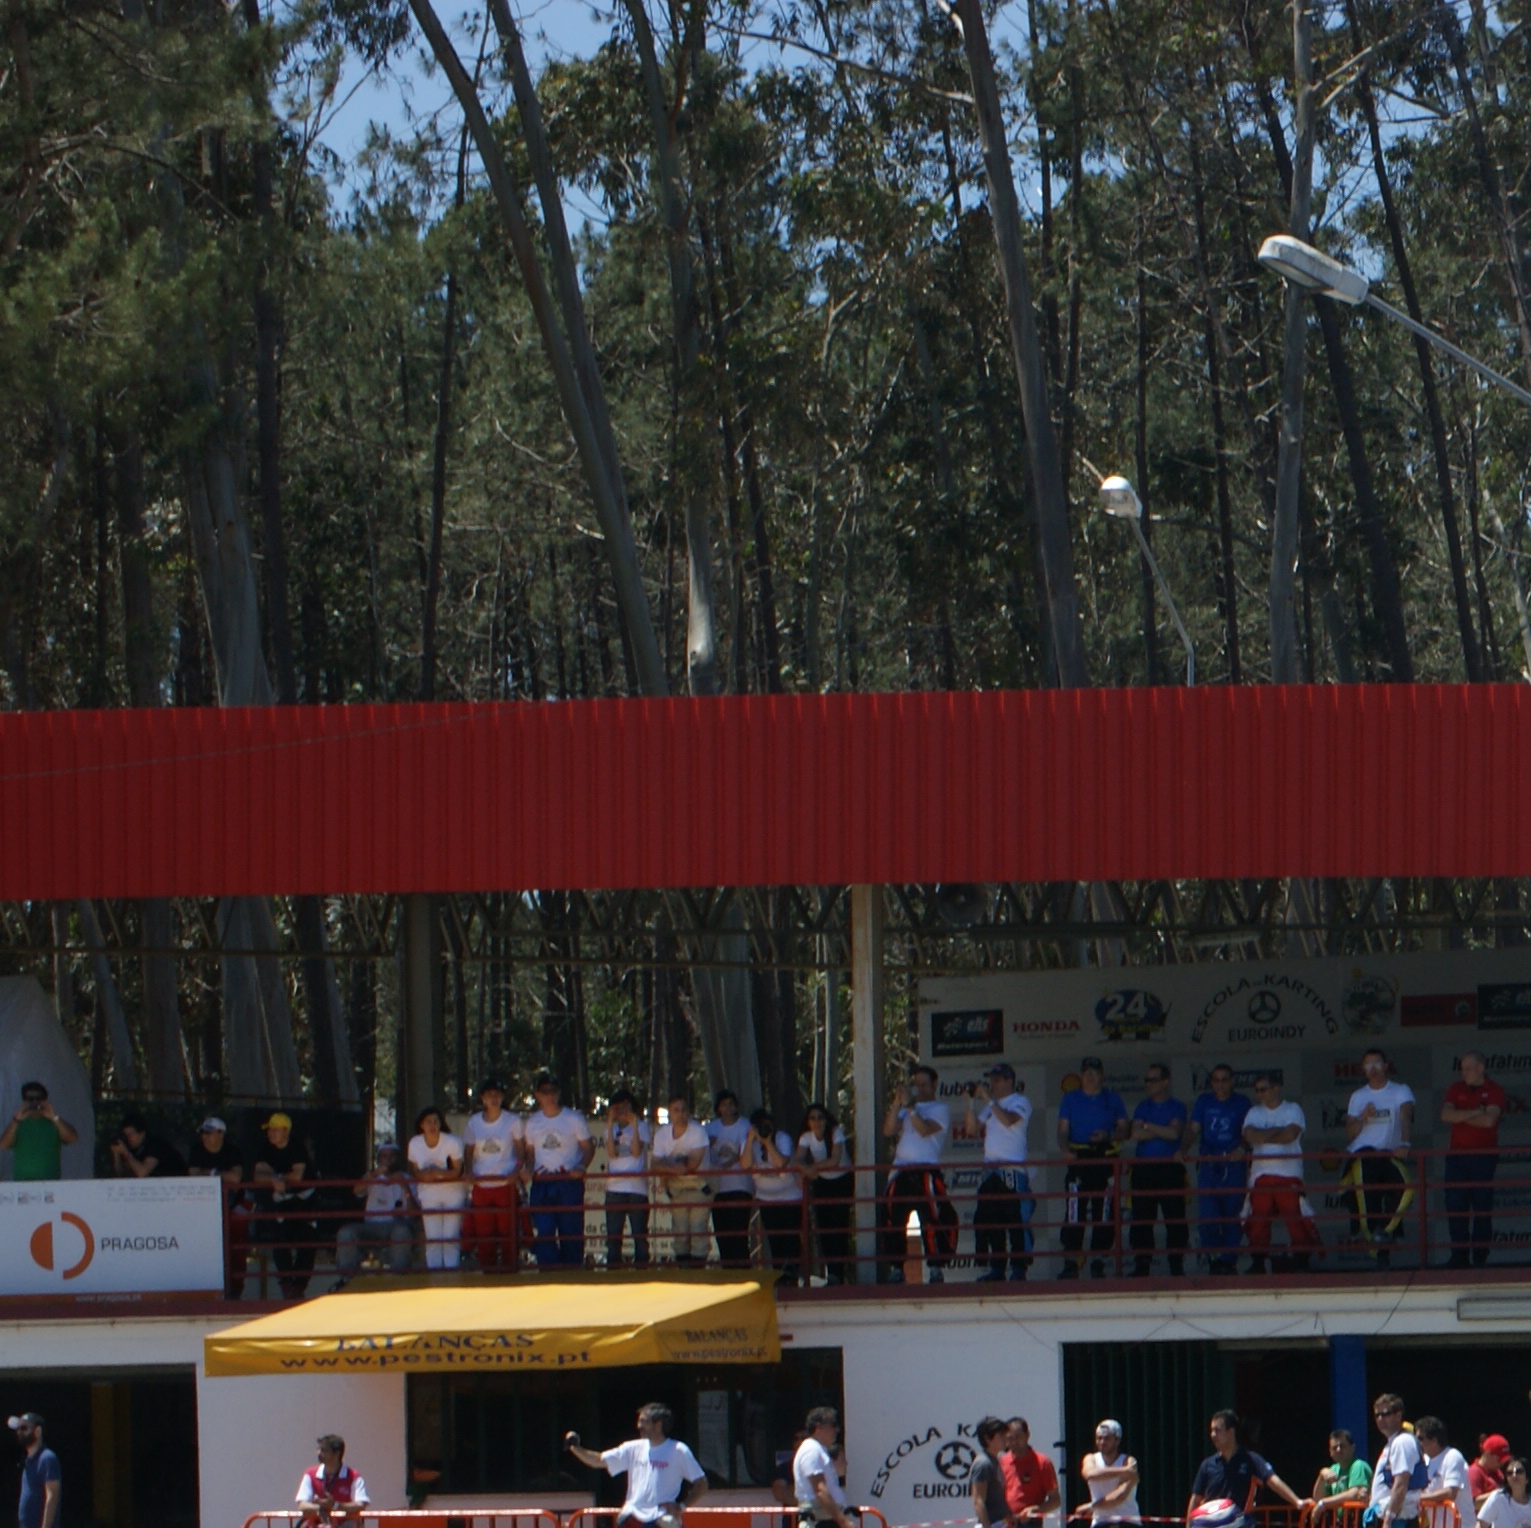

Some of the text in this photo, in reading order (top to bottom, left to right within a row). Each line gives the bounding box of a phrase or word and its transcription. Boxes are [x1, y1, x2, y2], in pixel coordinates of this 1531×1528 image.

[1104, 991, 1148, 1020] 24
[1191, 977, 1250, 1044] ESCOLA
[1263, 973, 1339, 1035] KARTING
[1012, 1020, 1082, 1033] HONDA
[1228, 1024, 1306, 1042] EUROINDY
[101, 1236, 180, 1251] PRAGOSA
[280, 1350, 592, 1368] www.pestronix.pt
[870, 1426, 942, 1499] ESCOLA
[913, 1482, 973, 1499] EUROI
